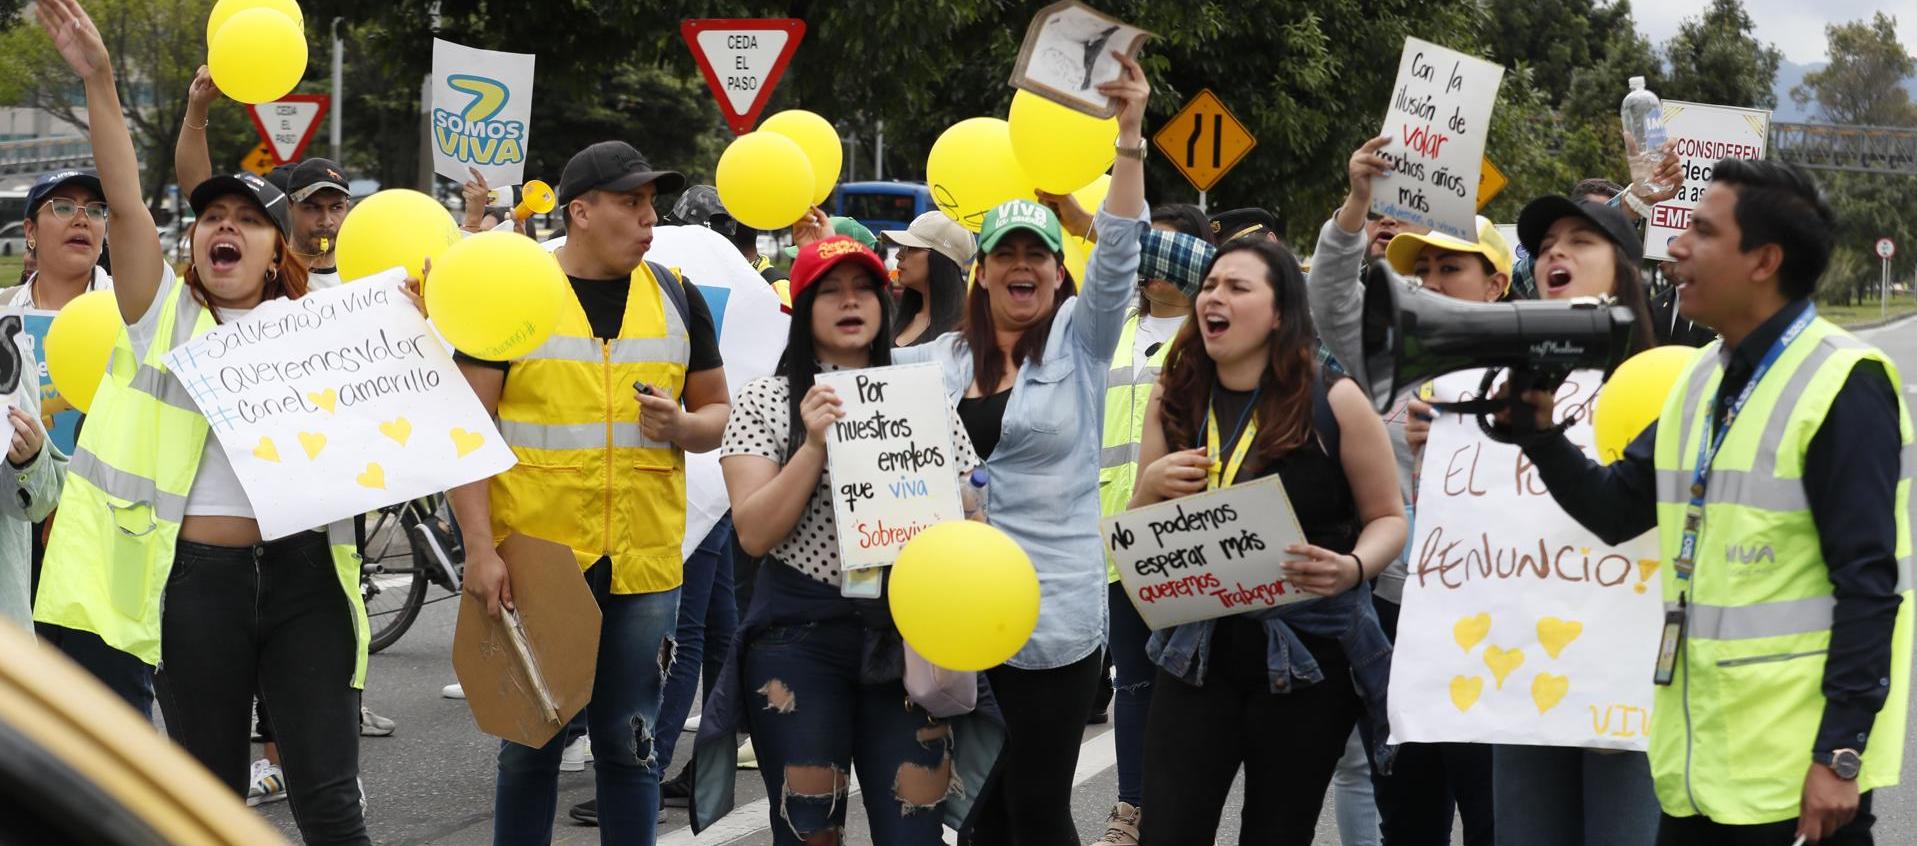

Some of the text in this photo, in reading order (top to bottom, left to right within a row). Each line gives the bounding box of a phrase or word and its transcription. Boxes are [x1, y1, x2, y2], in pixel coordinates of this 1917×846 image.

[727, 35, 758, 49] CEDA
[736, 55, 749, 70] EL
[1411, 52, 1463, 94] Con la
[727, 76, 757, 90] PASO
[276, 105, 297, 115] CEDA
[281, 120, 291, 130] EL
[435, 109, 523, 138] SOMOS
[1394, 84, 1466, 135] ilusión de
[275, 134, 296, 144] PASO
[436, 126, 522, 164] VIVA
[1403, 123, 1449, 160] volar
[1431, 167, 1466, 198] años
[1398, 185, 1430, 213] más
[1652, 206, 1693, 230] EMP
[339, 366, 440, 407] amarillo
[856, 375, 888, 404] Por
[835, 410, 912, 443] nuestros
[878, 441, 945, 472] empleos
[1444, 441, 1487, 496] EL
[841, 475, 928, 512] que viva
[1111, 504, 1237, 551] No podemos
[1135, 529, 1265, 577] esperar más
[1139, 572, 1220, 603] queremos
